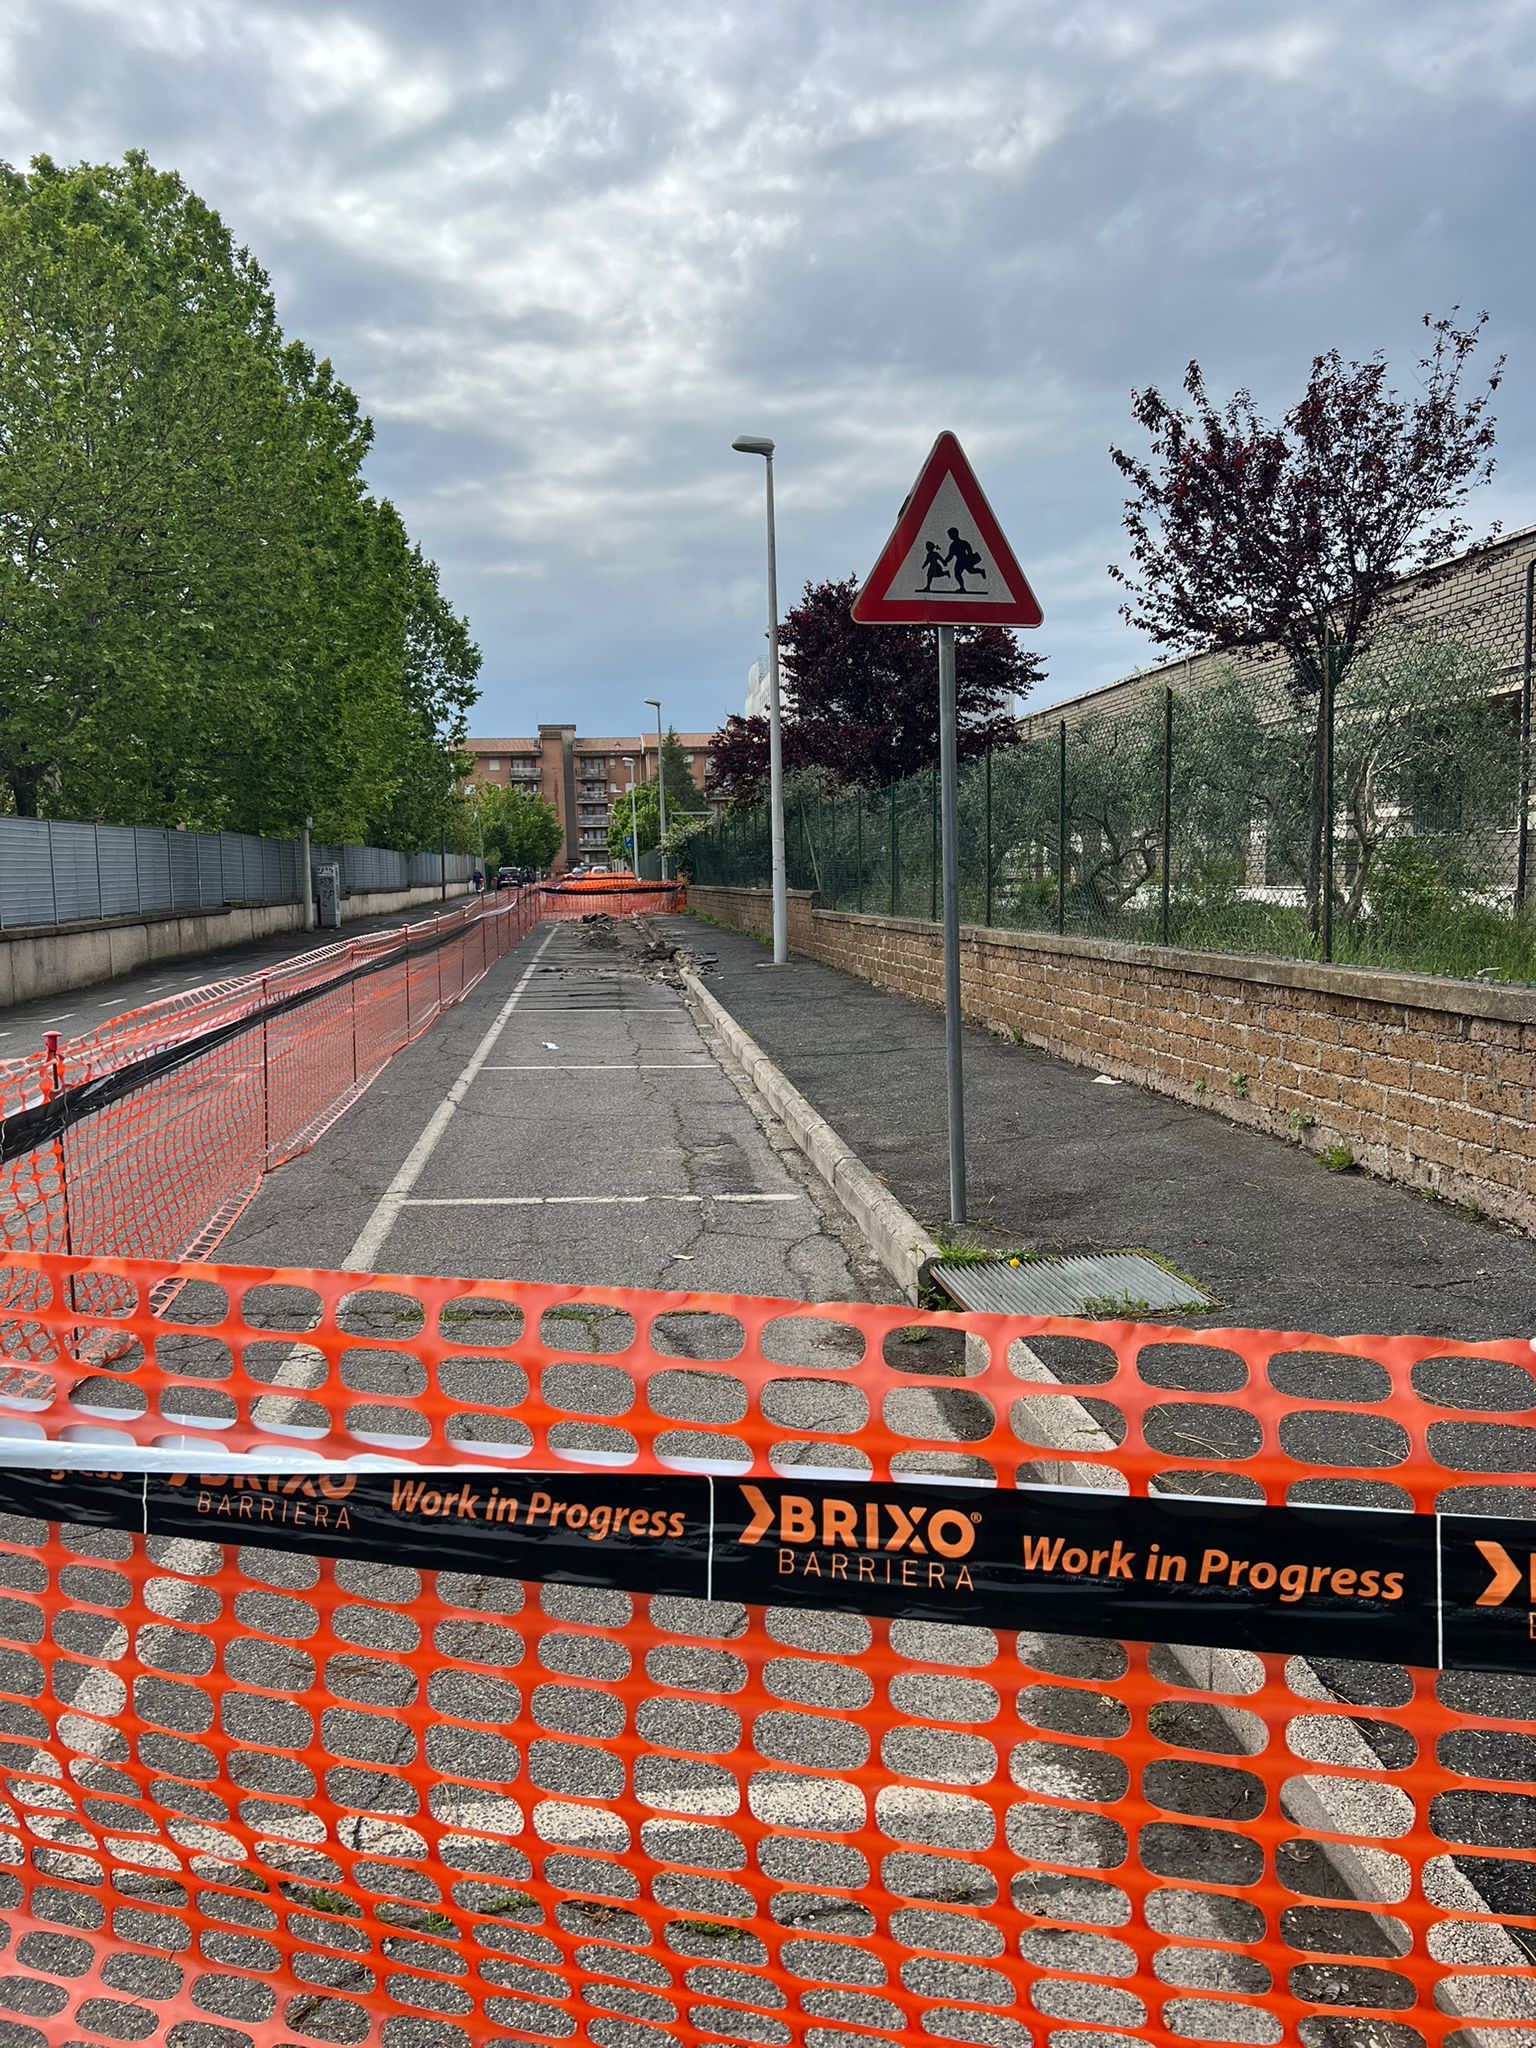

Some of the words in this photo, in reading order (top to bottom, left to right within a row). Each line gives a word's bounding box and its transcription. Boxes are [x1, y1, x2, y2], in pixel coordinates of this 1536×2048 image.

[197, 1490, 351, 1530] BARRIERA
[391, 1479, 480, 1518] Work
[486, 1487, 518, 1525] in
[526, 1492, 686, 1541] Progress
[778, 1549, 975, 1592] BARRIERA
[1023, 1535, 1136, 1579] Work
[1145, 1544, 1187, 1581] in
[1199, 1549, 1404, 1602] Progress
